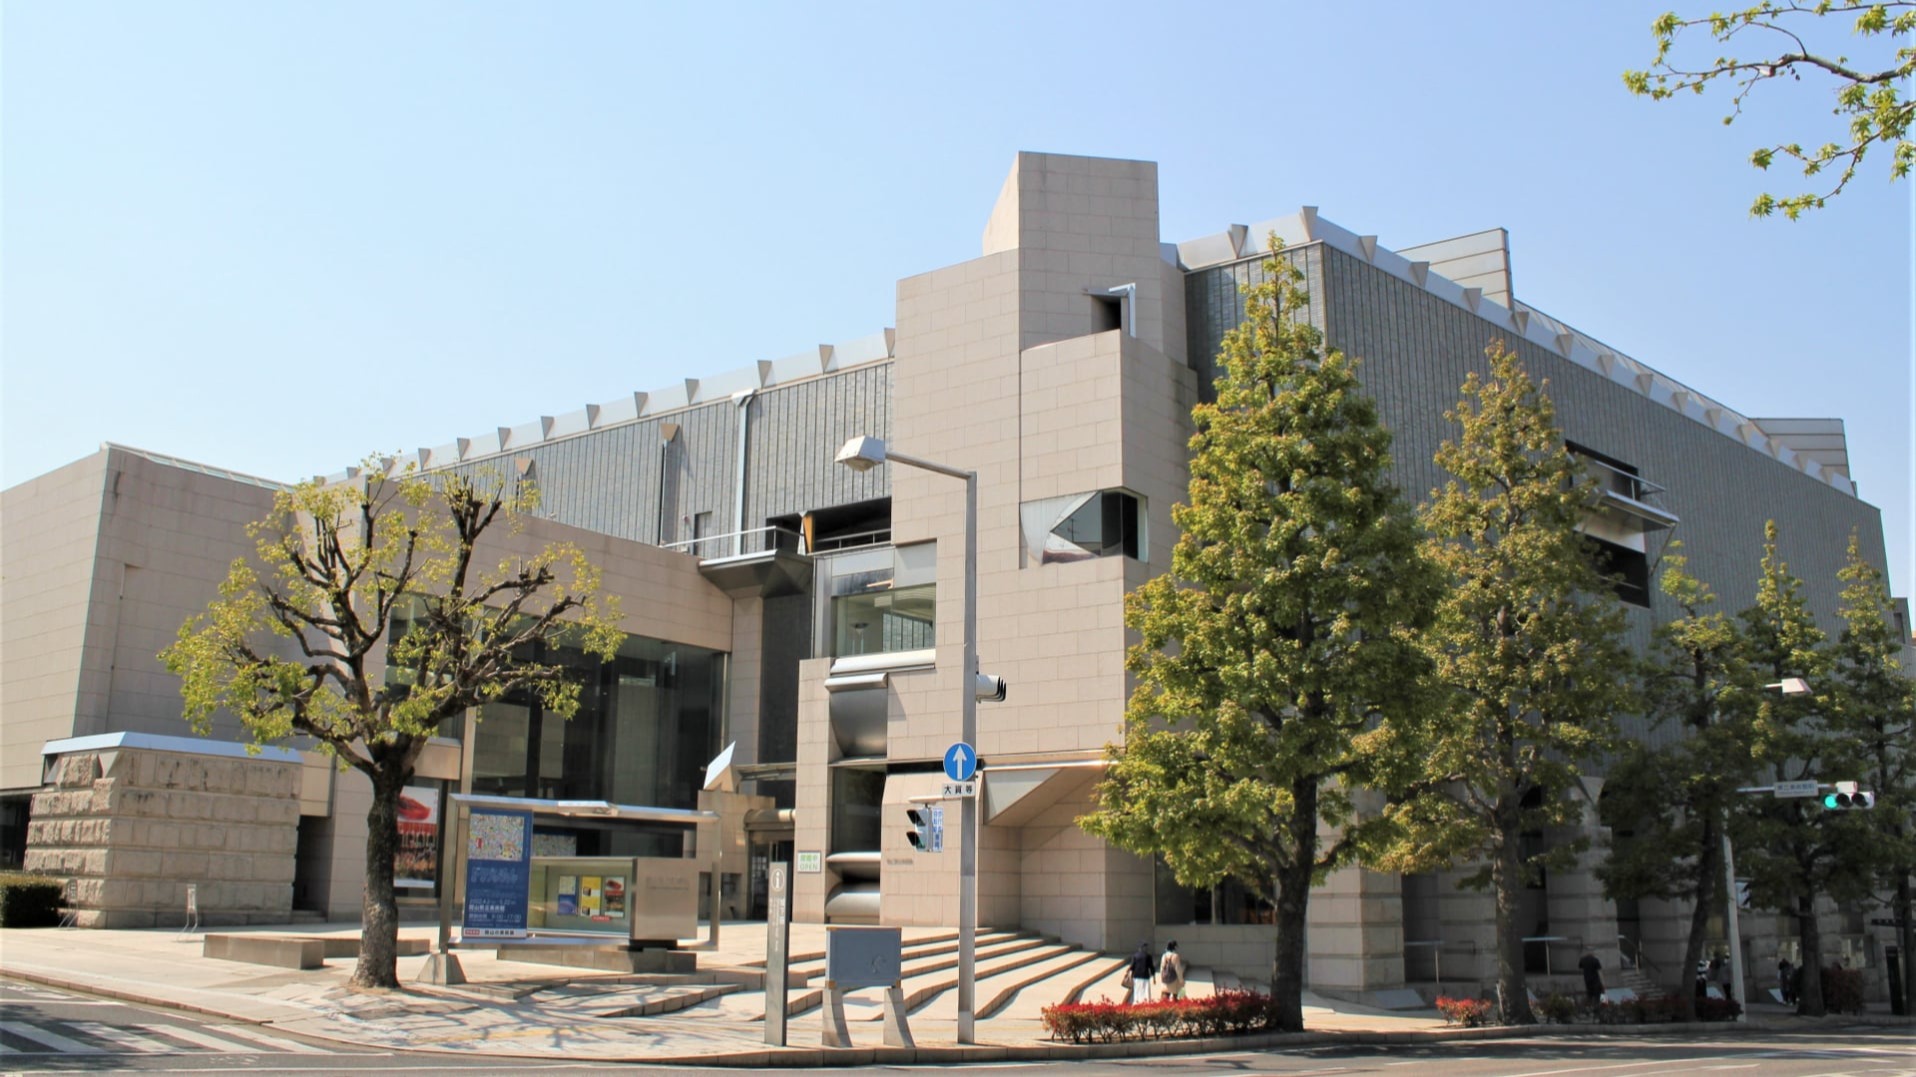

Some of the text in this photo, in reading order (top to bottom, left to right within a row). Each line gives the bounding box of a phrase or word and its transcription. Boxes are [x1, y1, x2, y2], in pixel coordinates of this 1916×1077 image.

[944, 785, 973, 795] 大貨等
[799, 863, 818, 871] OPEN
